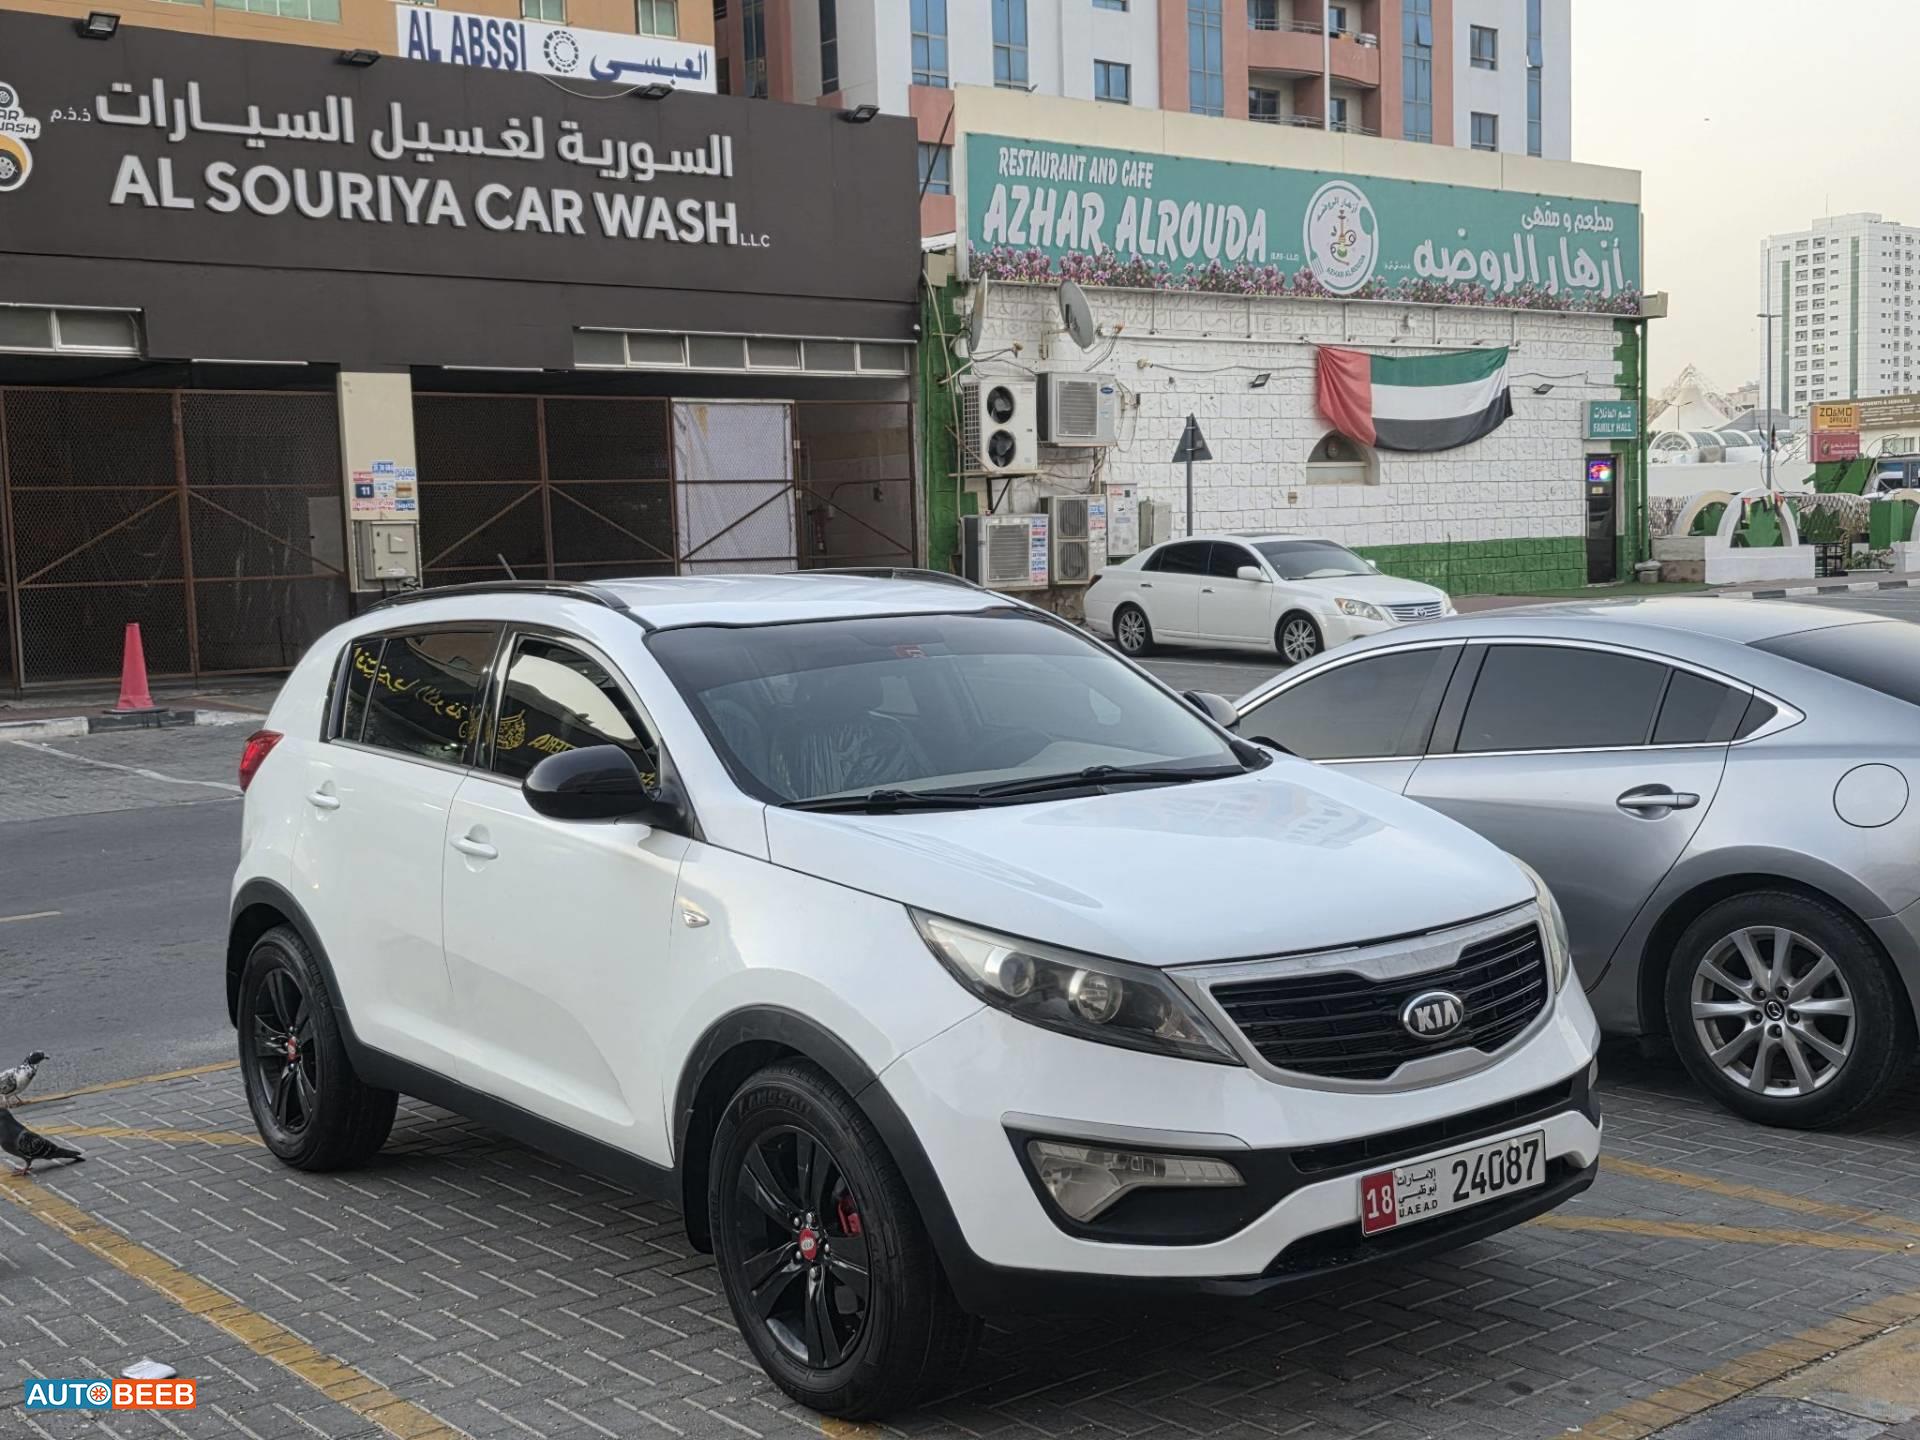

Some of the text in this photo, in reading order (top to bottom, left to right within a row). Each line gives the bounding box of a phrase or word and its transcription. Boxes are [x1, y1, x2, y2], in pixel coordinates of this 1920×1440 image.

[408, 9, 528, 71] AL ABSSI
[0, 109, 20, 121] AR
[95, 77, 356, 149] السيارات
[370, 102, 544, 163] لغسيل
[557, 120, 733, 182] السورية
[998, 147, 1154, 189] RESTAURANT AND CAFE
[109, 154, 196, 209] AL
[204, 161, 467, 227] SOURIYA
[474, 183, 586, 235] CAR
[592, 192, 738, 246] WASH
[983, 183, 1106, 257] AZHAR
[1115, 195, 1267, 263] ALROUDA
[1563, 212, 1572, 233] و
[1574, 205, 1614, 234] مطعم
[1547, 237, 1624, 299] أزهار
[1593, 422, 1632, 433] FAMILY HALL
[1617, 406, 1632, 420] قسم
[1415, 1000, 1459, 1032] KIA
[1452, 1138, 1540, 1202] 24087
[1366, 1185, 1393, 1219] 18
